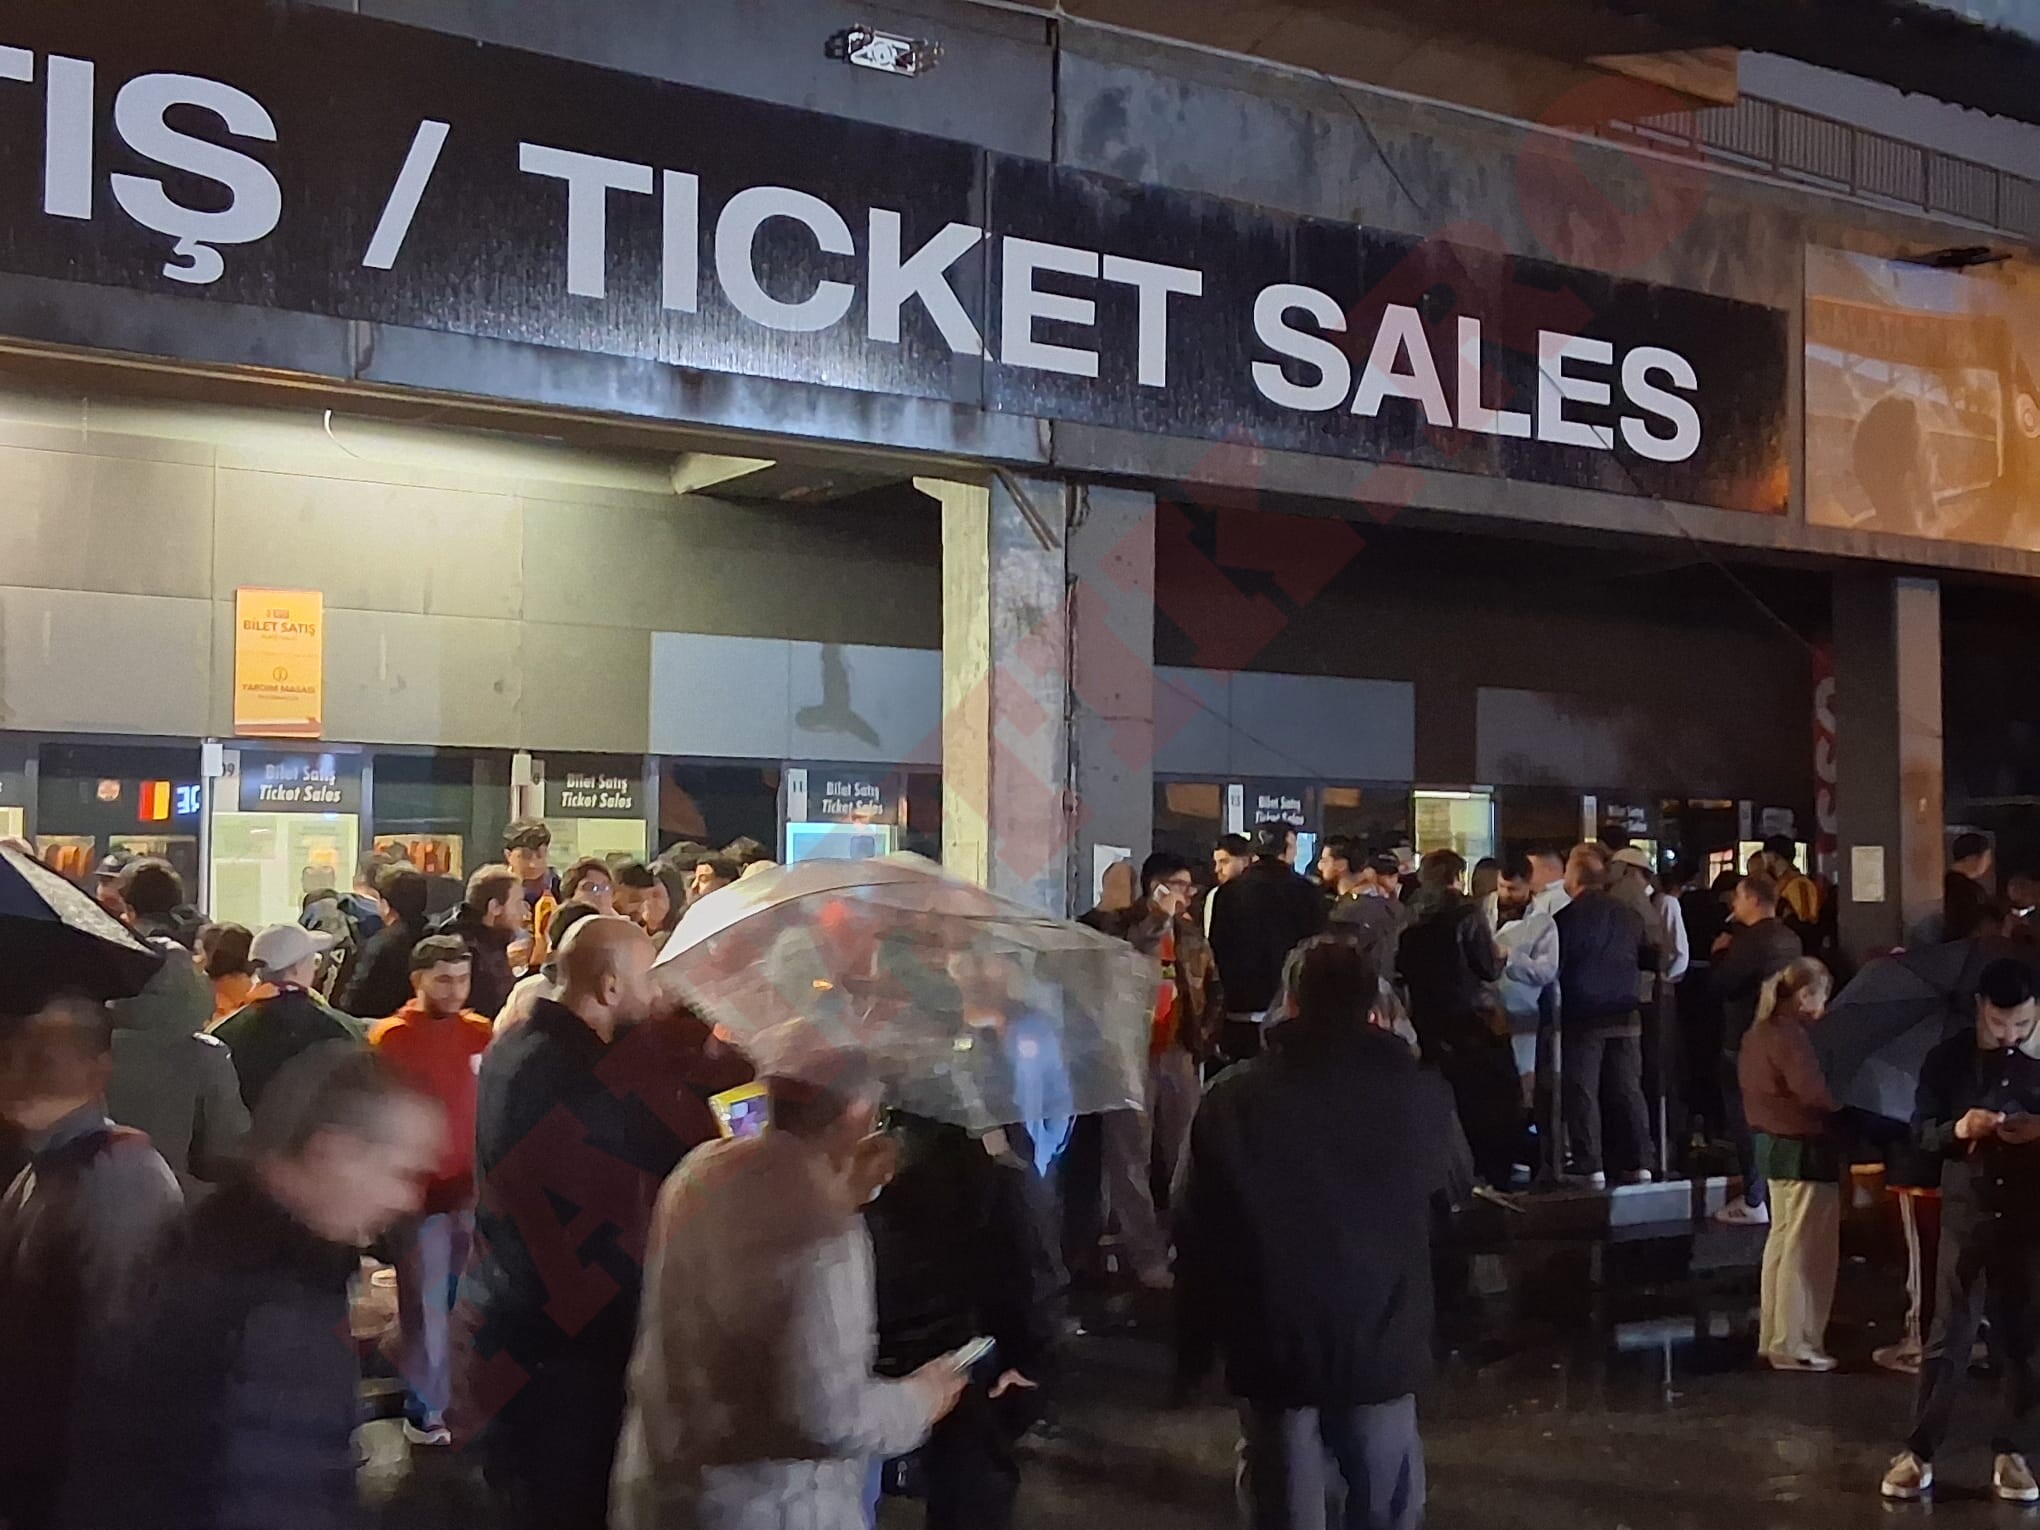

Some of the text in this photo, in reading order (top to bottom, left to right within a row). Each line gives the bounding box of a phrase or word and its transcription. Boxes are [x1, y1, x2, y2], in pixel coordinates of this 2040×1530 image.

[362, 119, 451, 270] /
[518, 141, 1202, 388] TICKET
[1251, 282, 1701, 462] SALES
[280, 621, 316, 637] SATIŞ
[566, 772, 597, 789] Bilet
[259, 783, 342, 802] Ticket Sales
[561, 791, 633, 808] Ticket Sales
